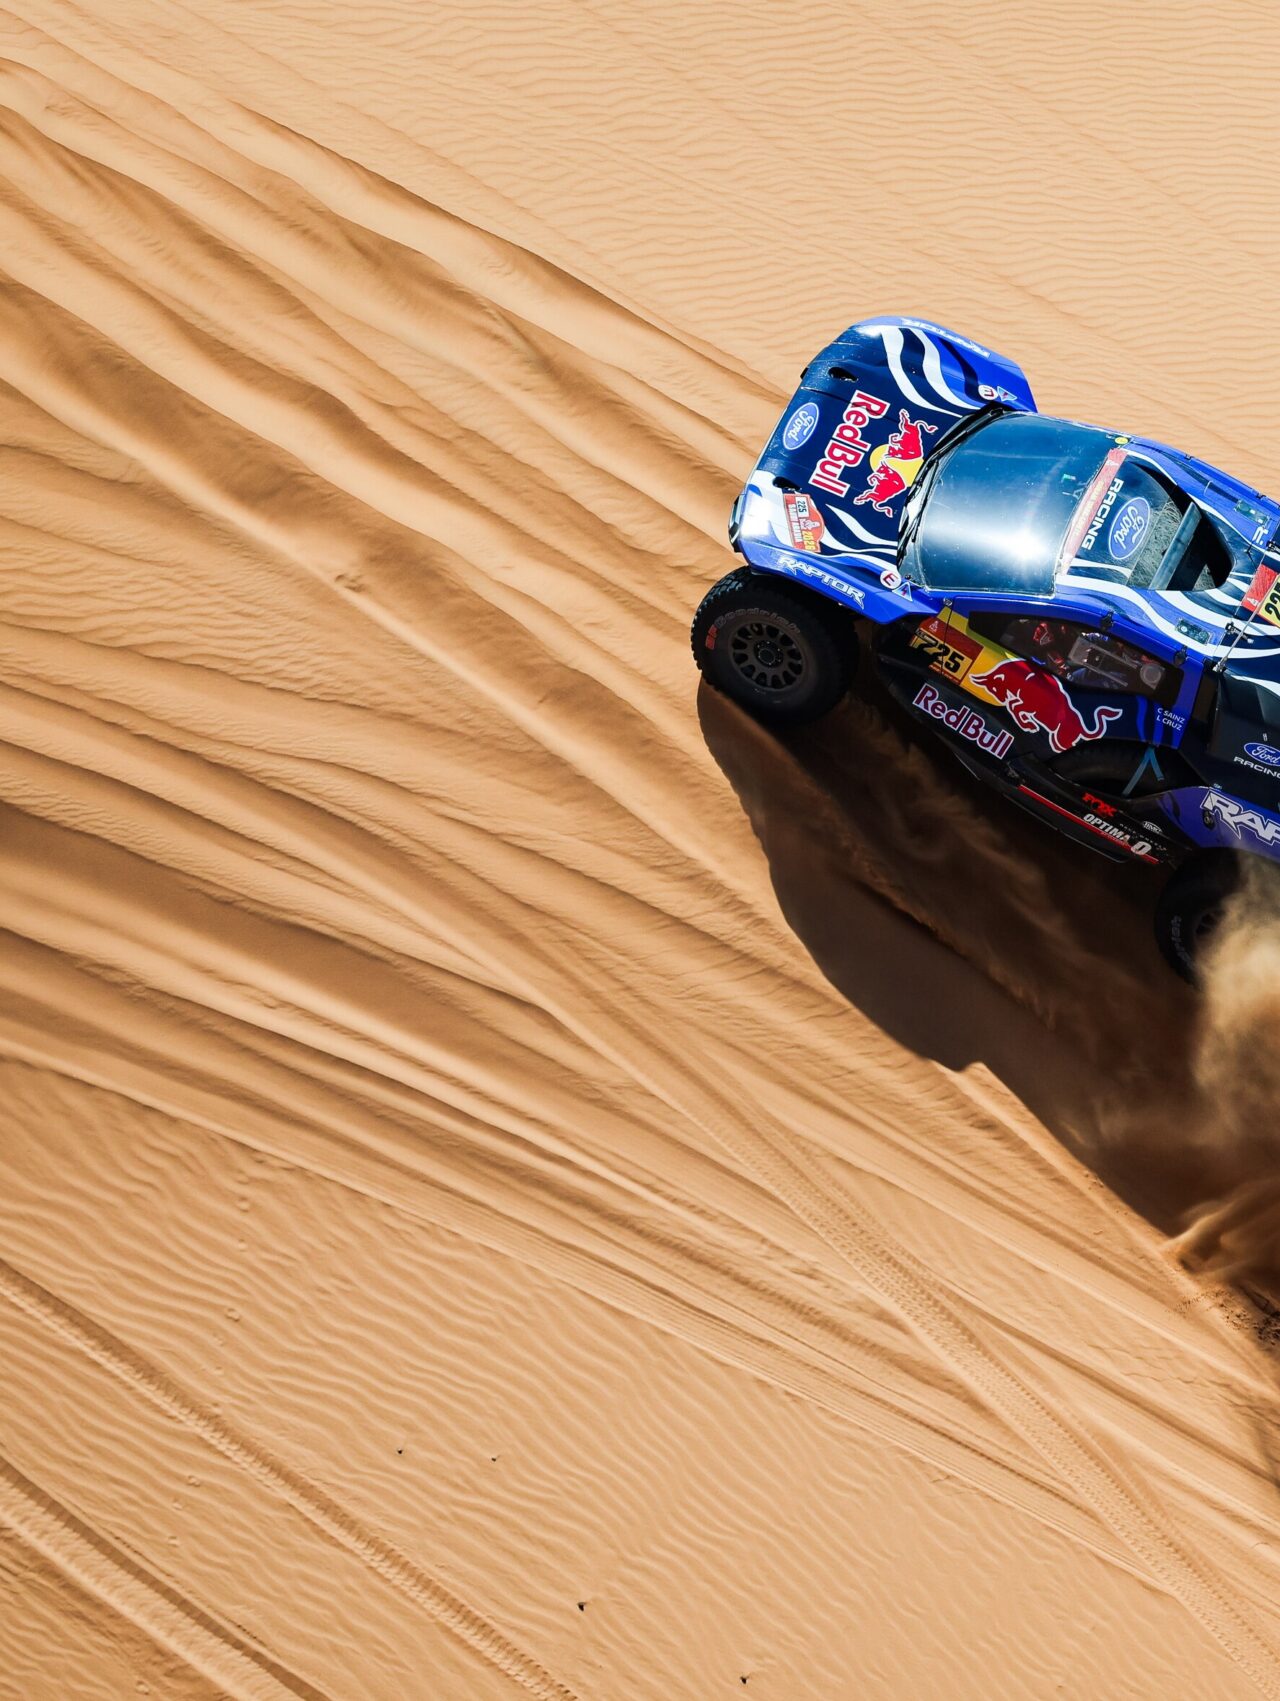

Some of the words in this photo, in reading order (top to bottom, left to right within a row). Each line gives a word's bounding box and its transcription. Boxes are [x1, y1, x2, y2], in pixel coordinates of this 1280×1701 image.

[786, 405, 817, 443] Ford
[797, 500, 807, 513] 225
[1082, 478, 1124, 550] RACING
[1114, 505, 1145, 549] Ford
[777, 556, 865, 610] RAPTOR
[1162, 717, 1183, 731] CRUZ
[1163, 710, 1186, 725] SAINZ
[1083, 813, 1131, 843] OPTIMA
